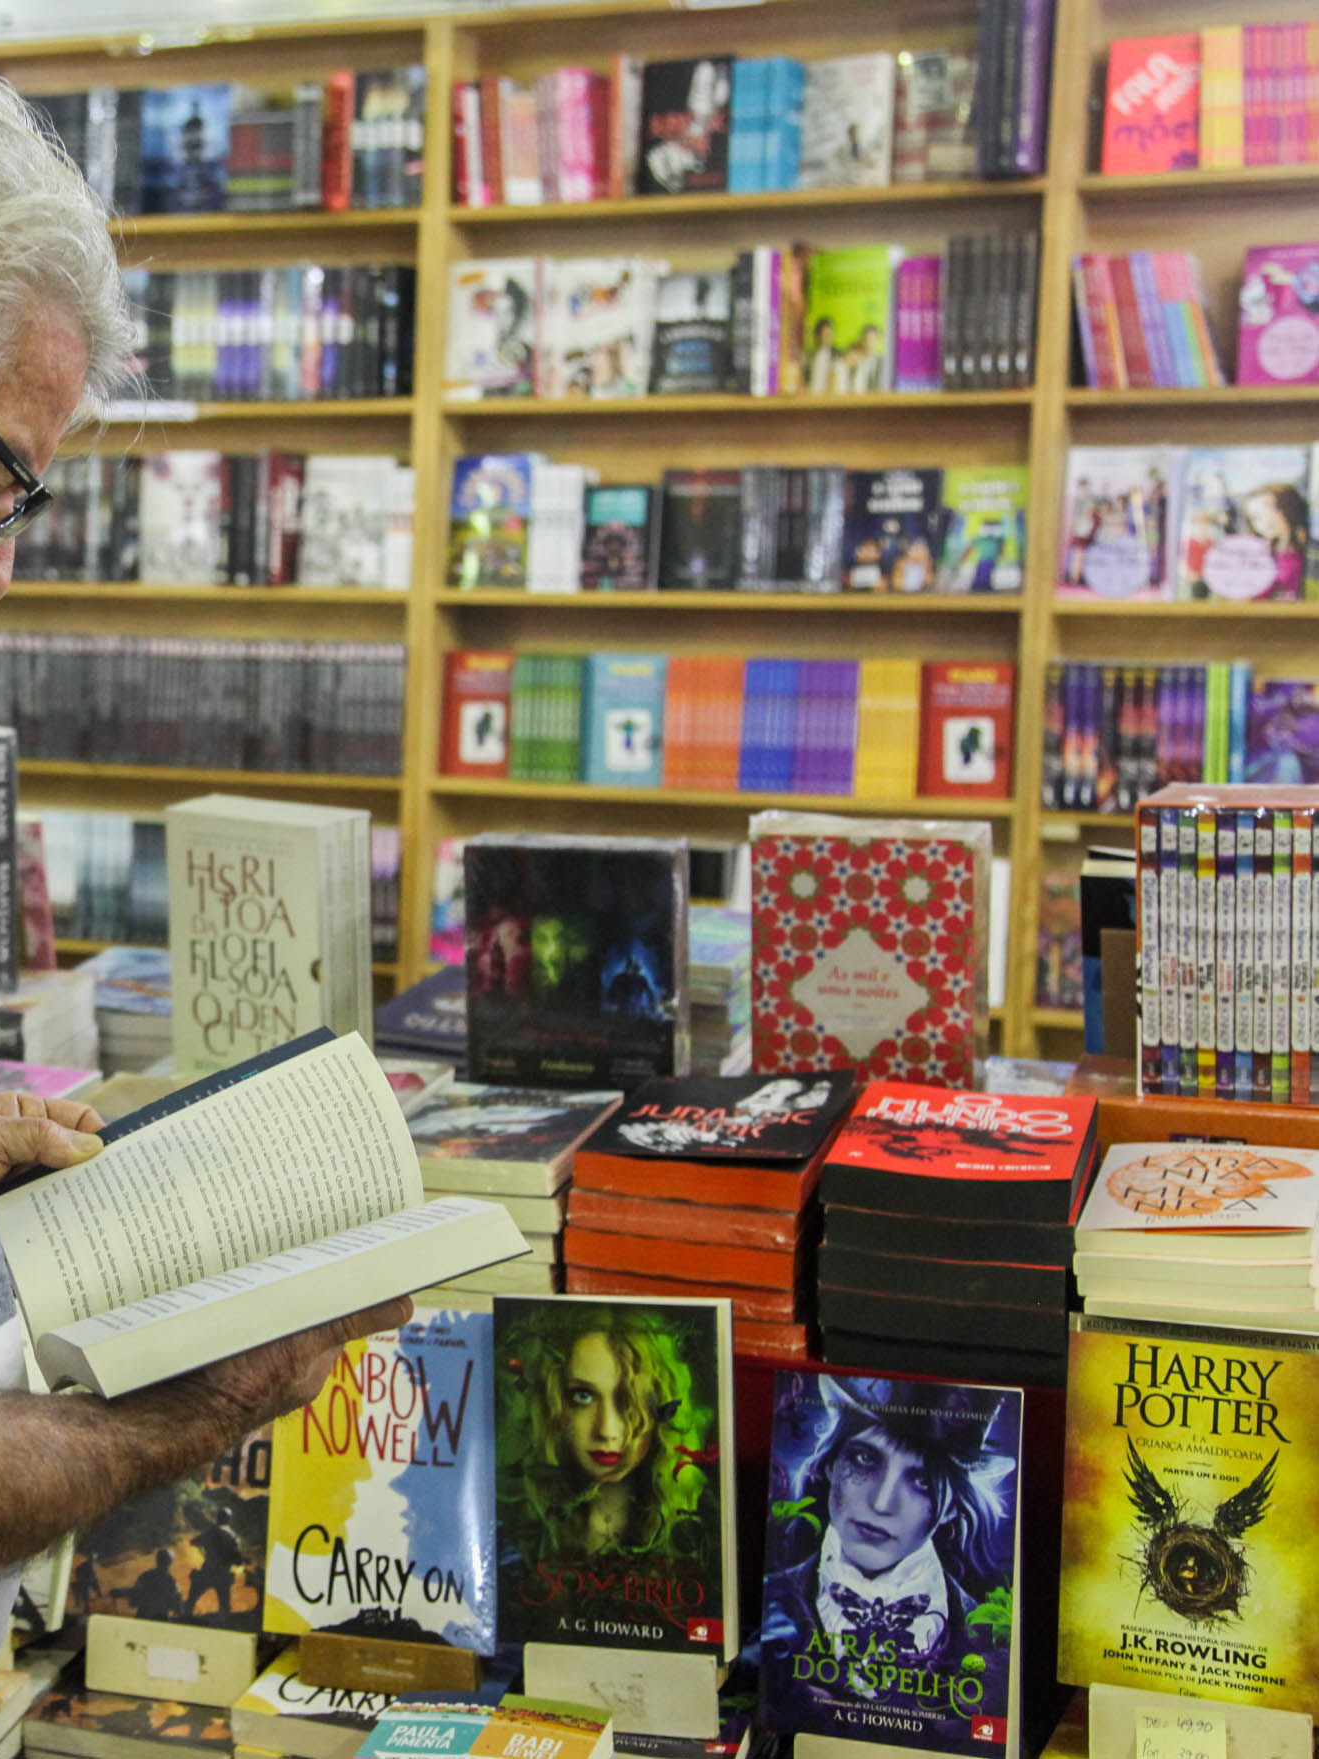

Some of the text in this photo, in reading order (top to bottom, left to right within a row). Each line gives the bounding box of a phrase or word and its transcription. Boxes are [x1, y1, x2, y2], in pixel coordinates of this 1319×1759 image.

[1125, 1342, 1284, 1400] HARRY
[1112, 1382, 1293, 1444] POTTER
[1135, 1437, 1264, 1462] CRIANÇA AMALDIÇOADA
[1163, 1467, 1194, 1477] PARTES
[1196, 1470, 1211, 1479] UM
[1219, 1473, 1241, 1483] DOIS
[293, 1523, 465, 1606] CARRY ON
[594, 1620, 664, 1640] HOWARD
[806, 1628, 898, 1664] ATRÁS
[1120, 1632, 1267, 1669] J.K. ROWLING
[1221, 1640, 1257, 1652] ORIGINAL
[792, 1654, 984, 1705] DO ESPELHO
[1102, 1648, 1286, 1687] JOHN TIFFANY & JACK THORNE
[1122, 1664, 1139, 1673] UMA
[1140, 1667, 1162, 1677] NOVA
[1198, 1677, 1221, 1688] JACK
[1224, 1681, 1265, 1694] THORNE
[394, 1725, 456, 1740] PAULA
[862, 1712, 923, 1733] HOWARD
[385, 1735, 452, 1749] PIMENTA
[508, 1732, 563, 1752] BABI
